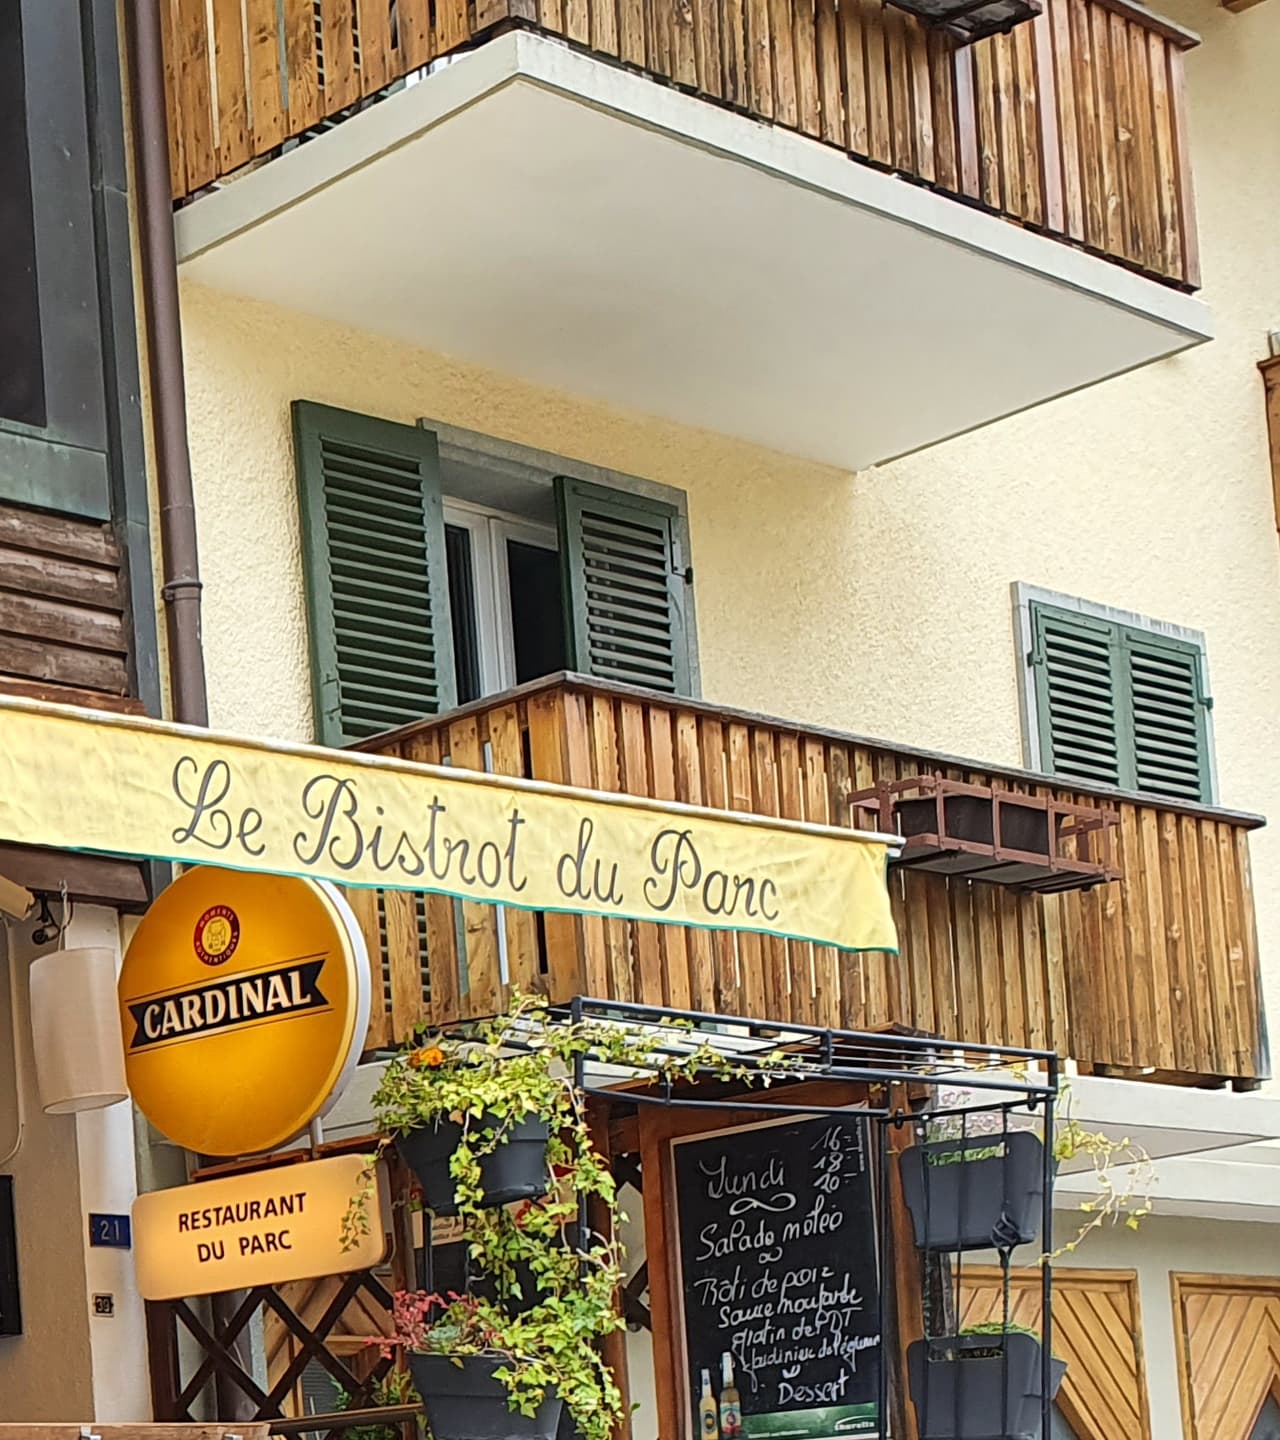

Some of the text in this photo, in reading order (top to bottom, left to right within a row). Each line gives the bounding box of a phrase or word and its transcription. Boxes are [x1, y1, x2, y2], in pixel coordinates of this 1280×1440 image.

[172, 755, 780, 921] Le Bistrot du Parc
[142, 969, 312, 1040] CARDINAL
[99, 1219, 121, 1241] 21
[177, 1191, 307, 1233] RESTAURANT
[196, 1229, 293, 1263] DU PARC
[750, 1268, 779, 1299] de
